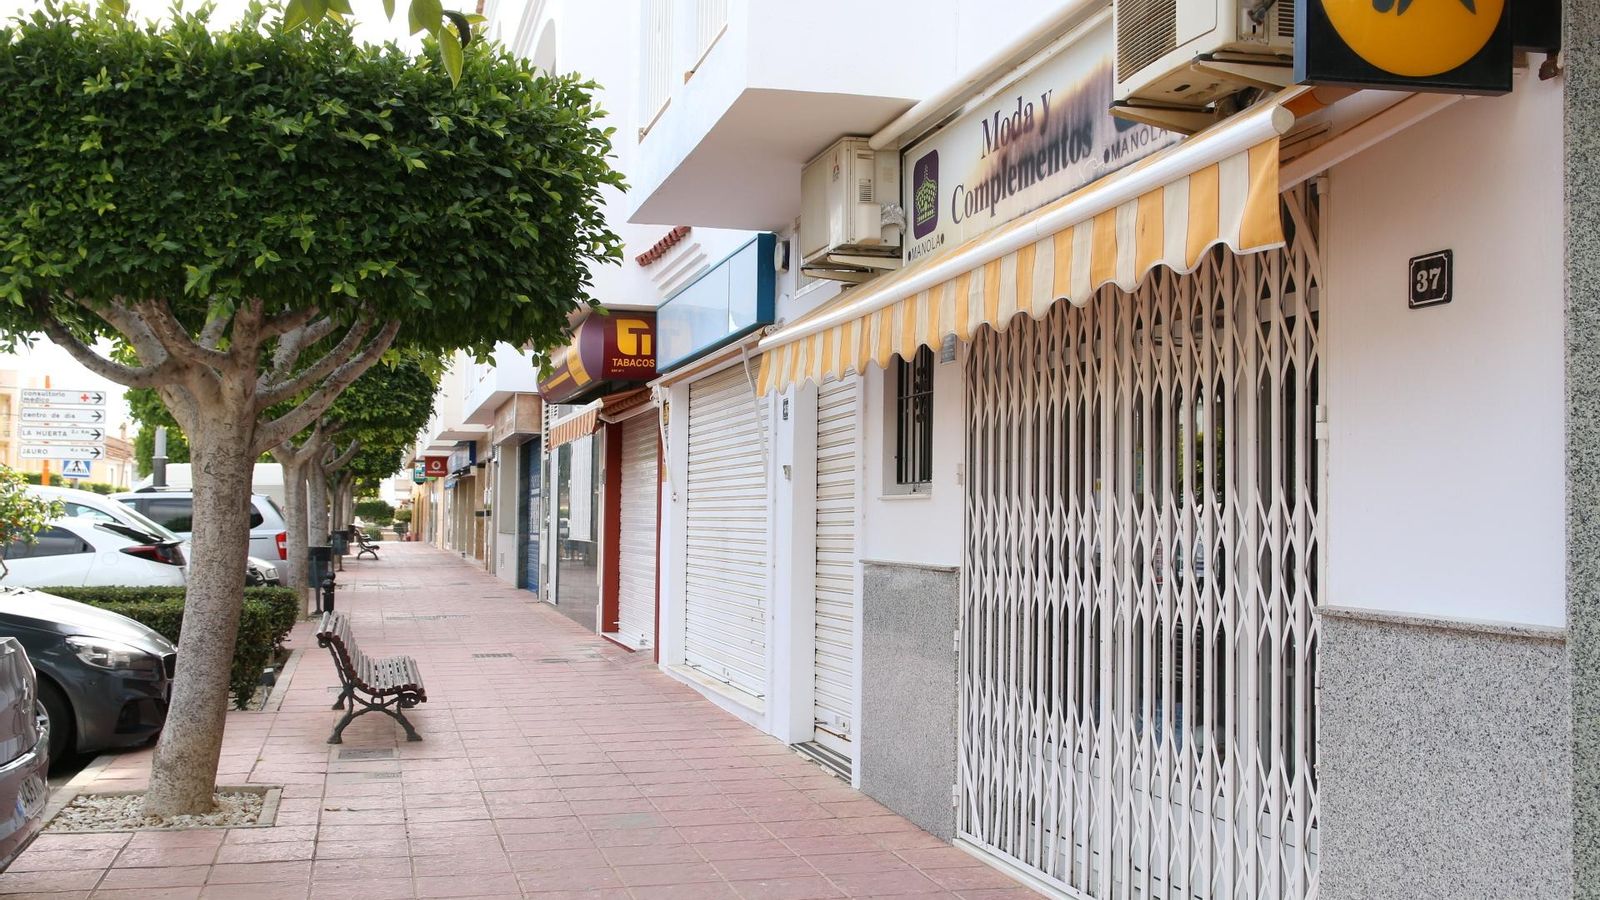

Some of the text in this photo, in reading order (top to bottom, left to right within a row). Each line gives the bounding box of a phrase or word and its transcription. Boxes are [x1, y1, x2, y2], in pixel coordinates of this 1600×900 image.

[981, 96, 1034, 160] Moda
[951, 119, 1093, 225] Complementos
[1416, 267, 1442, 293] 37
[612, 358, 655, 367] TABACOS
